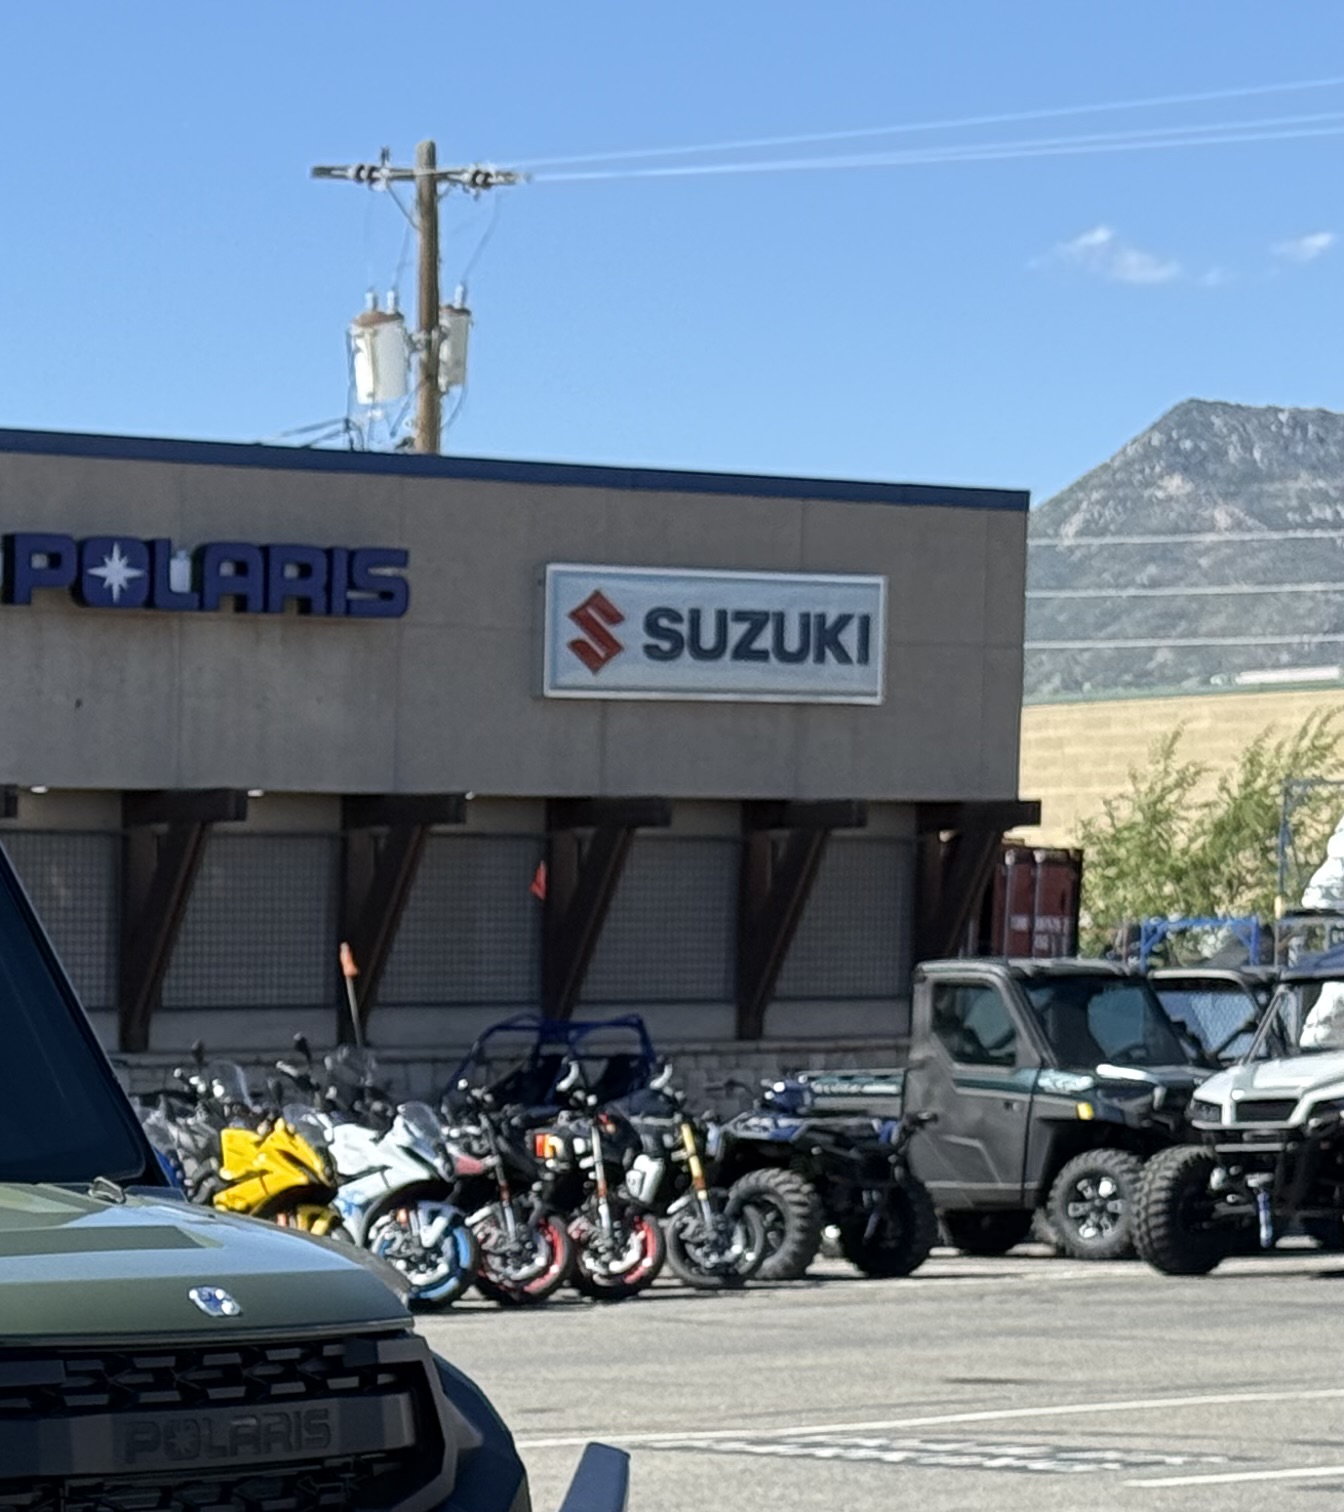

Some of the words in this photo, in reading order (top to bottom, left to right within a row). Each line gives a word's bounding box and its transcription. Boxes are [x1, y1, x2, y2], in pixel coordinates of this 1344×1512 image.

[1, 533, 410, 619] POLARIS
[643, 606, 870, 665] SUZUKI
[124, 1408, 331, 1464] POLARIS
